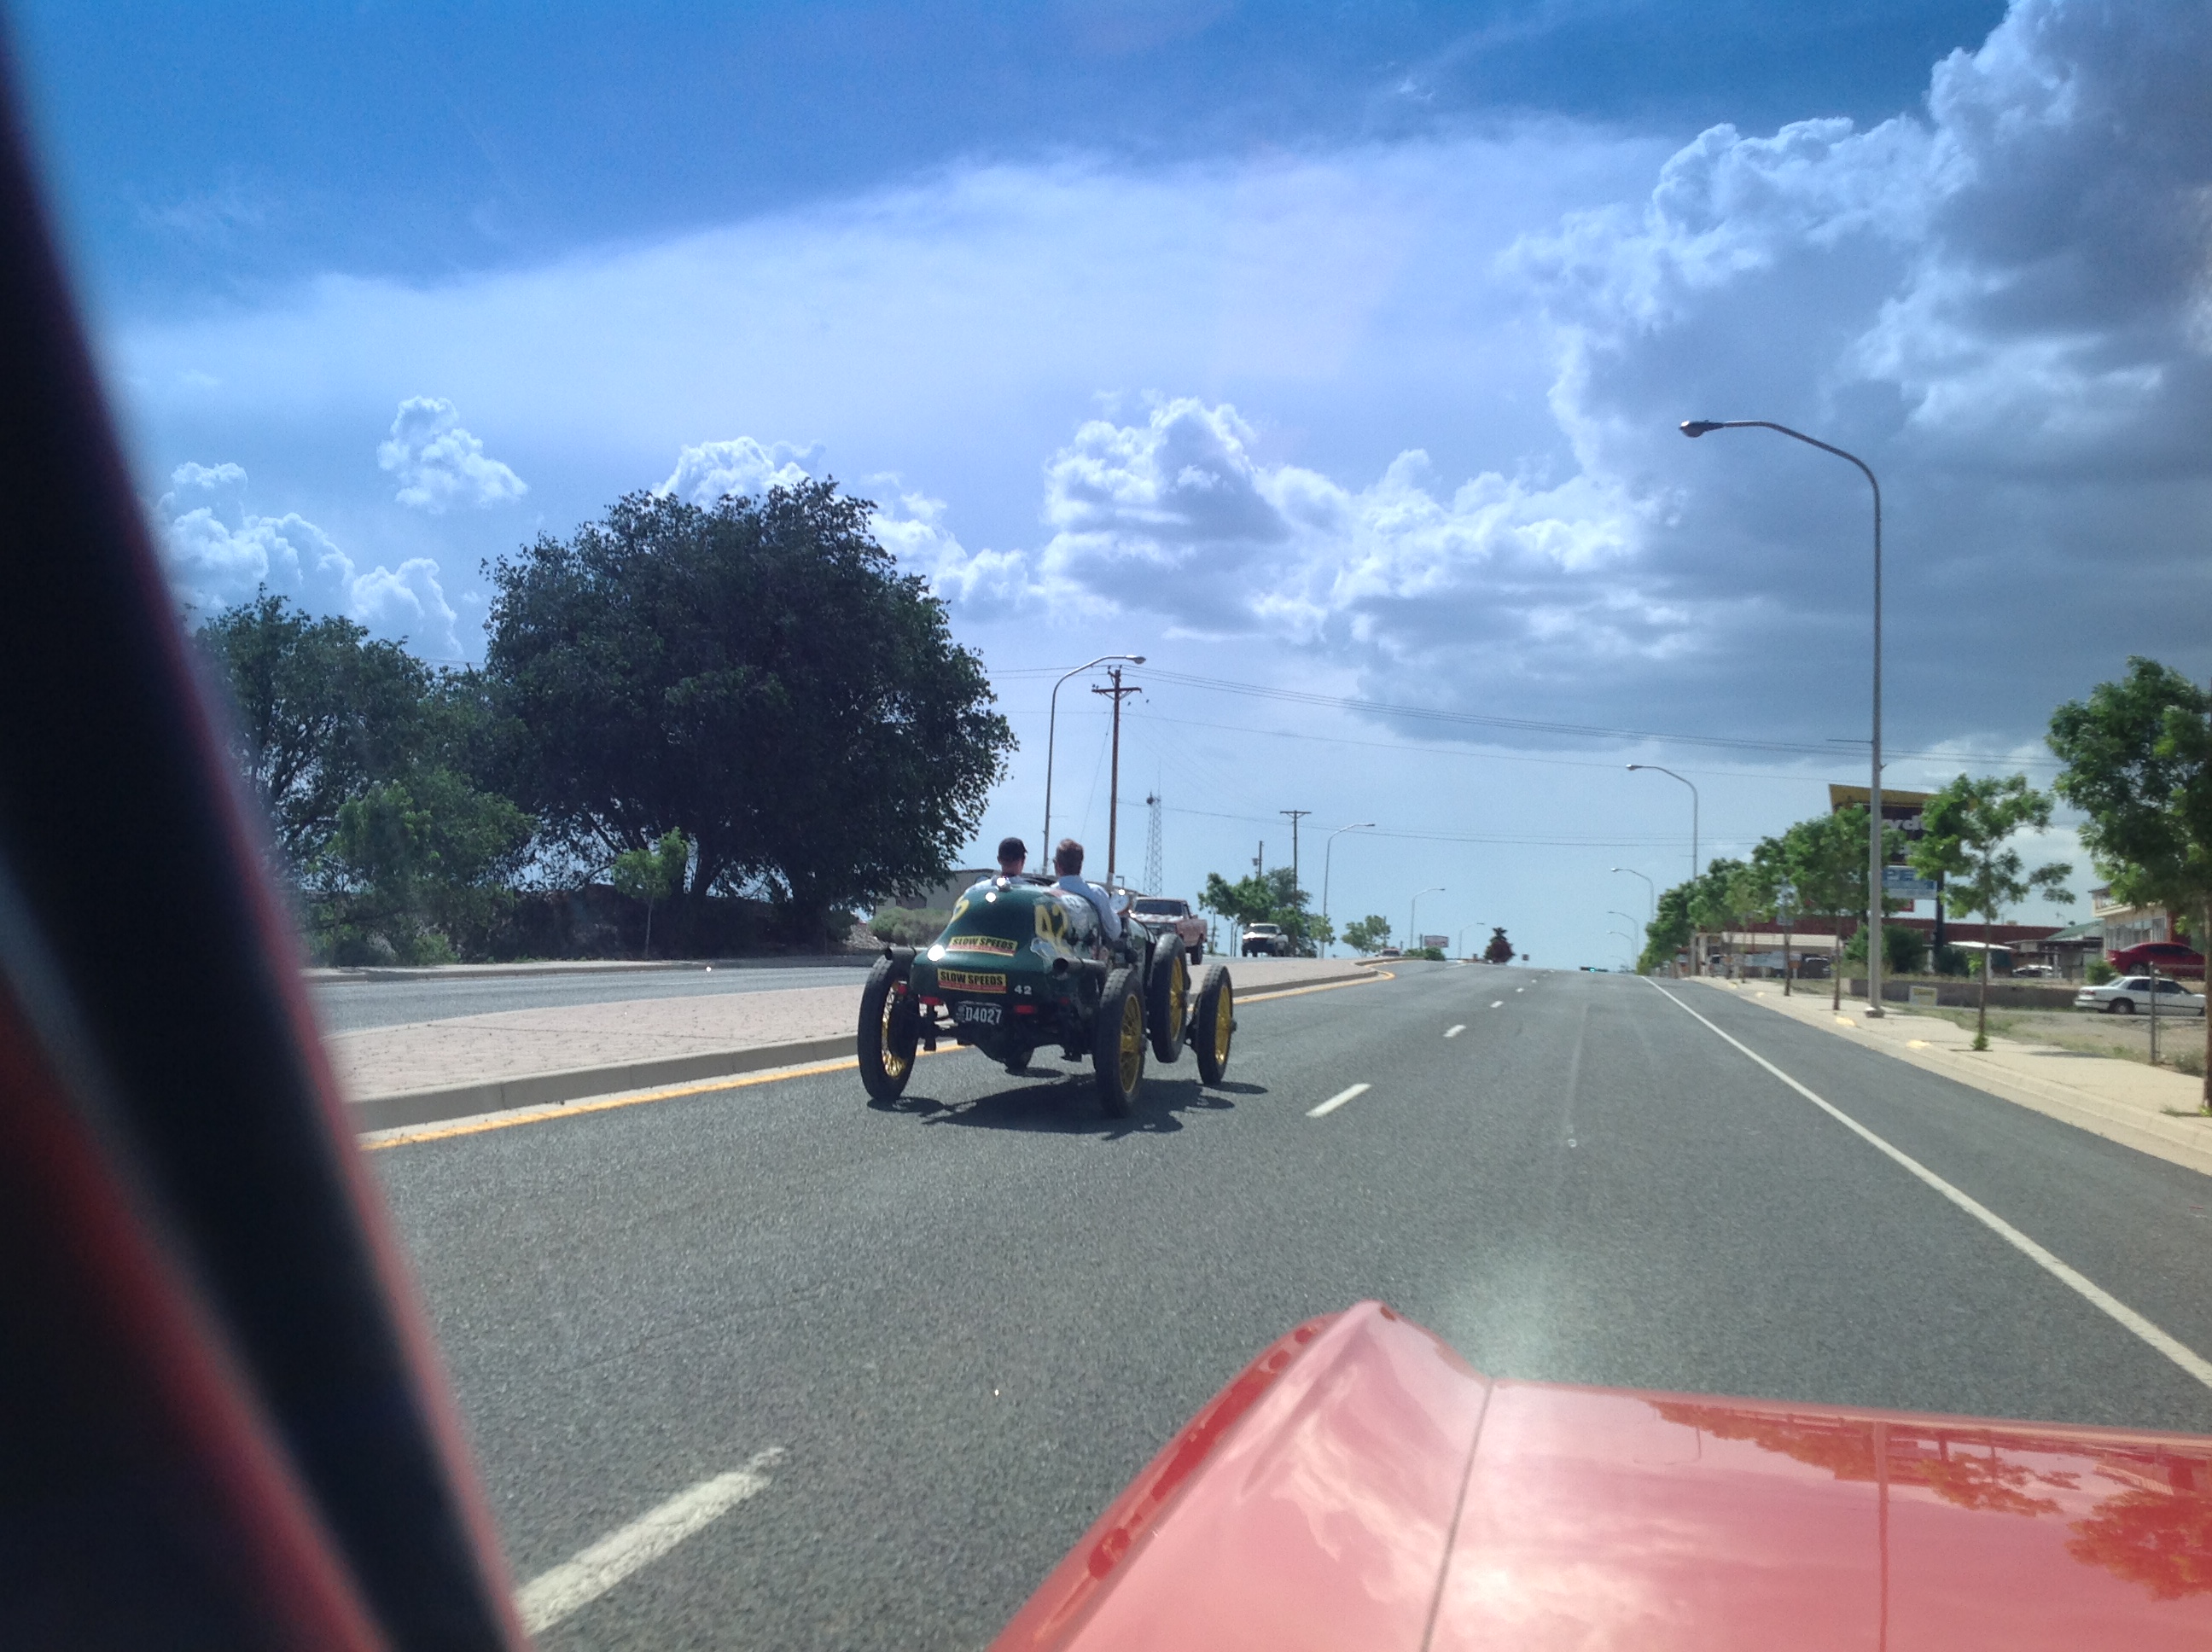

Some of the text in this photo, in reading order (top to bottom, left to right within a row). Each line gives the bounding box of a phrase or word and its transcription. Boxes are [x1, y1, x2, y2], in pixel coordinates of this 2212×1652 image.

[1034, 904, 1072, 953] 42
[952, 937, 979, 946] SLOW
[979, 936, 1014, 950] SPEEDS
[940, 971, 966, 983] SLOW
[968, 974, 1004, 986] SPEEDS
[1014, 985, 1033, 996] 42
